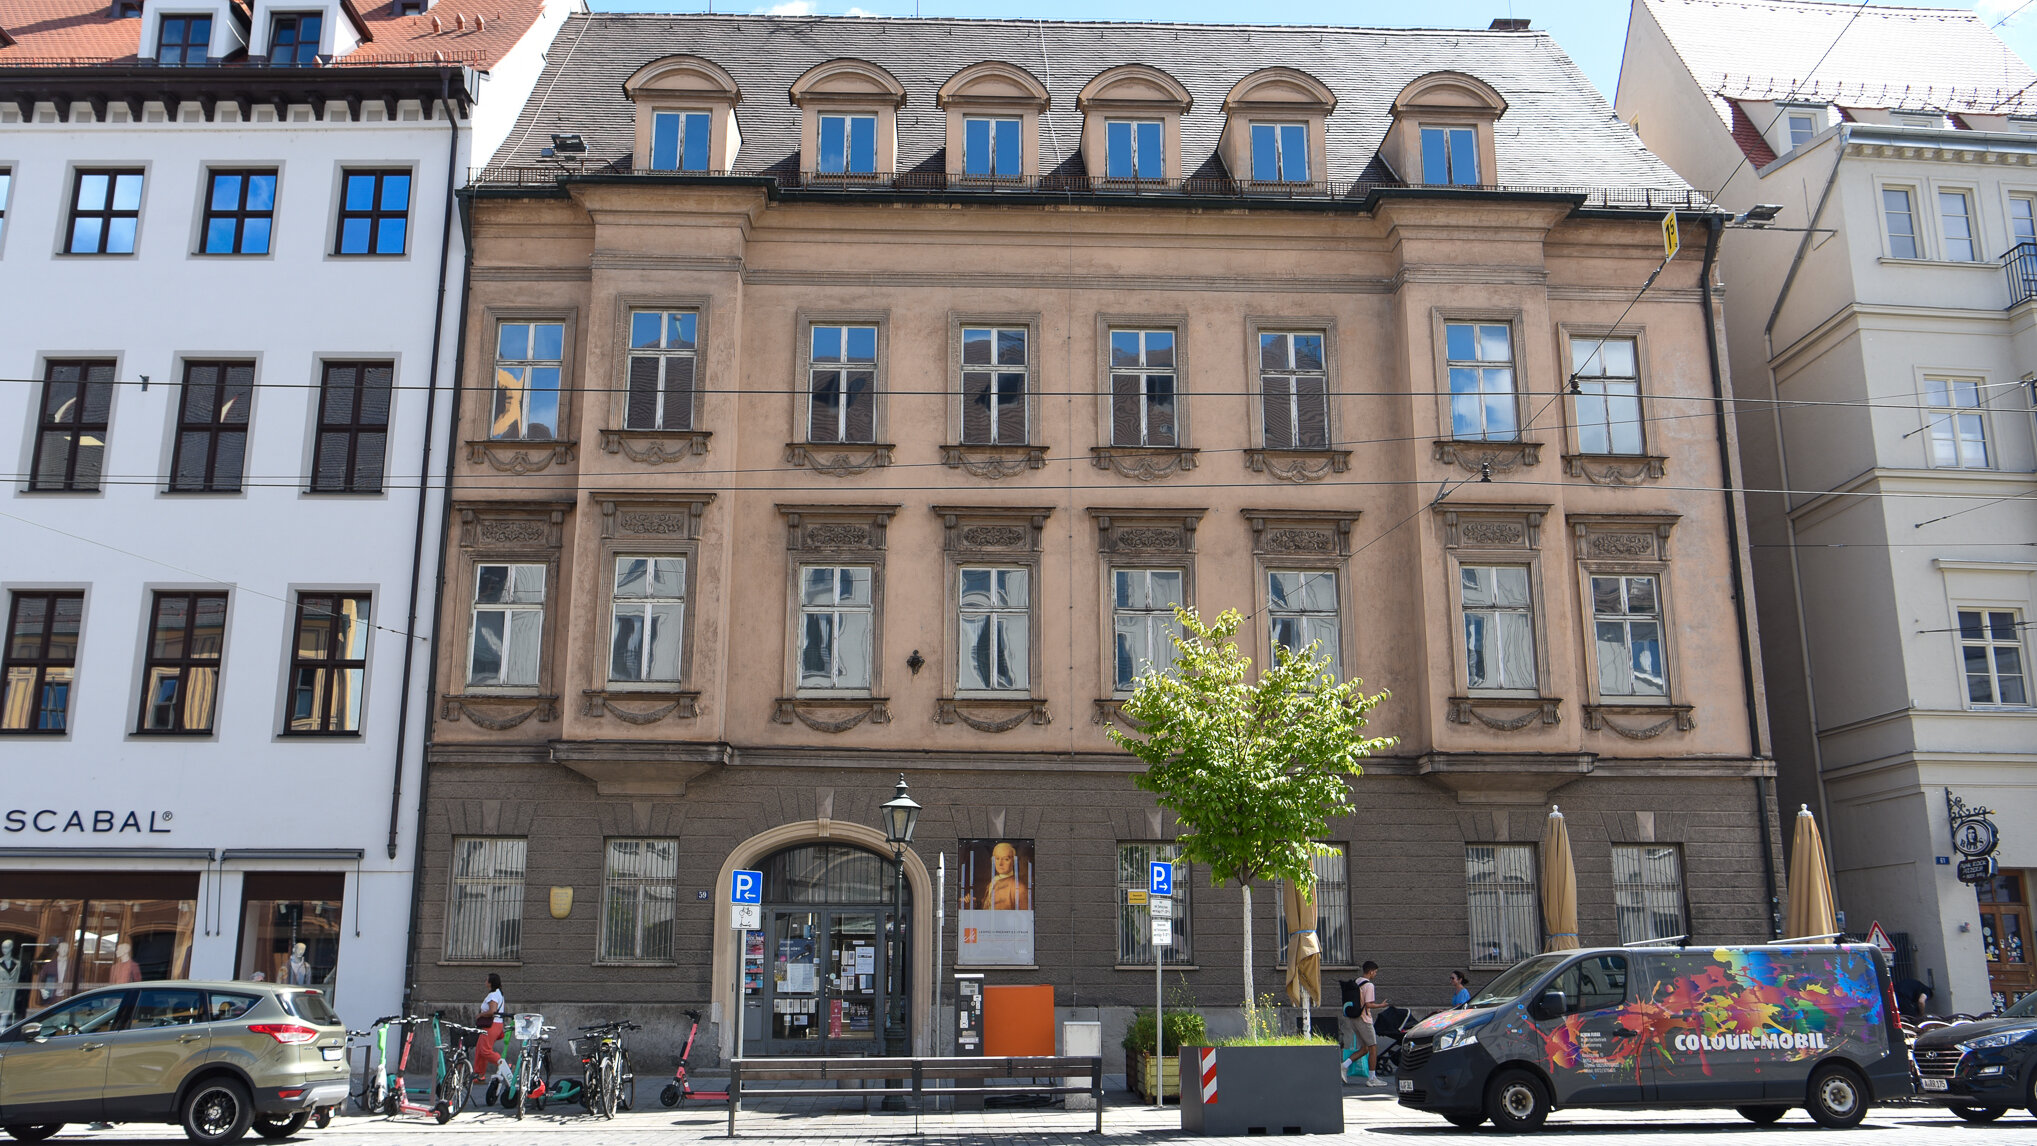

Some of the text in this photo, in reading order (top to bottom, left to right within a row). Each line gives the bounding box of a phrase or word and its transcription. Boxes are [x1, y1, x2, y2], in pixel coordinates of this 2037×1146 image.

[736, 874, 753, 899] P
[1153, 866, 1166, 890] P
[698, 891, 707, 899] 59
[1674, 1032, 1828, 1051] COLOUR-MOBIL
